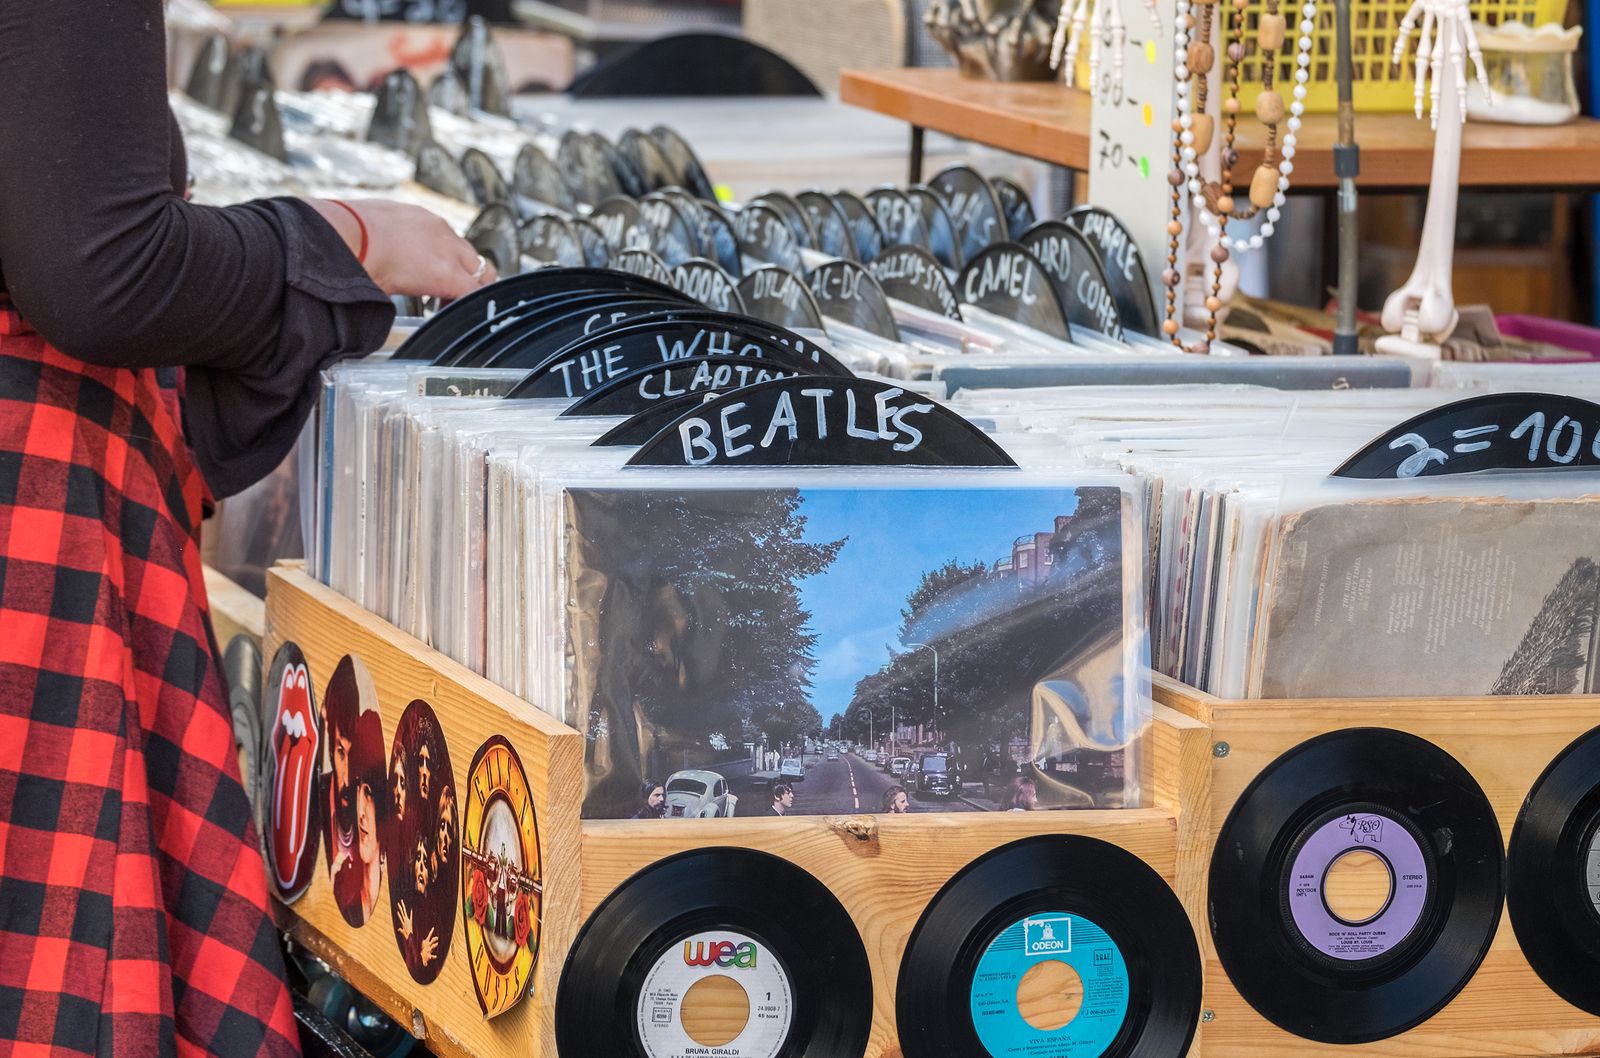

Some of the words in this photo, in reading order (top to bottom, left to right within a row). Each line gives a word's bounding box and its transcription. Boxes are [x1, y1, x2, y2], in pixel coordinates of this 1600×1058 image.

[1082, 213, 1137, 281] PURPLE
[674, 266, 731, 311] DOORS
[753, 270, 800, 311] DYLAN
[810, 265, 862, 301] AC-DC
[965, 252, 1037, 305] CAMEL
[550, 344, 629, 399] THE
[639, 361, 799, 399] CLAPT
[678, 387, 935, 465] BEATLES
[473, 750, 511, 806] GUNS
[1359, 819, 1380, 833] RSO
[683, 940, 757, 969] wea
[1031, 940, 1064, 951] ODEON
[765, 991, 771, 1001] 1
[711, 1048, 740, 1056] GIRALDI
[1046, 1035, 1072, 1043] ESPAÑA
